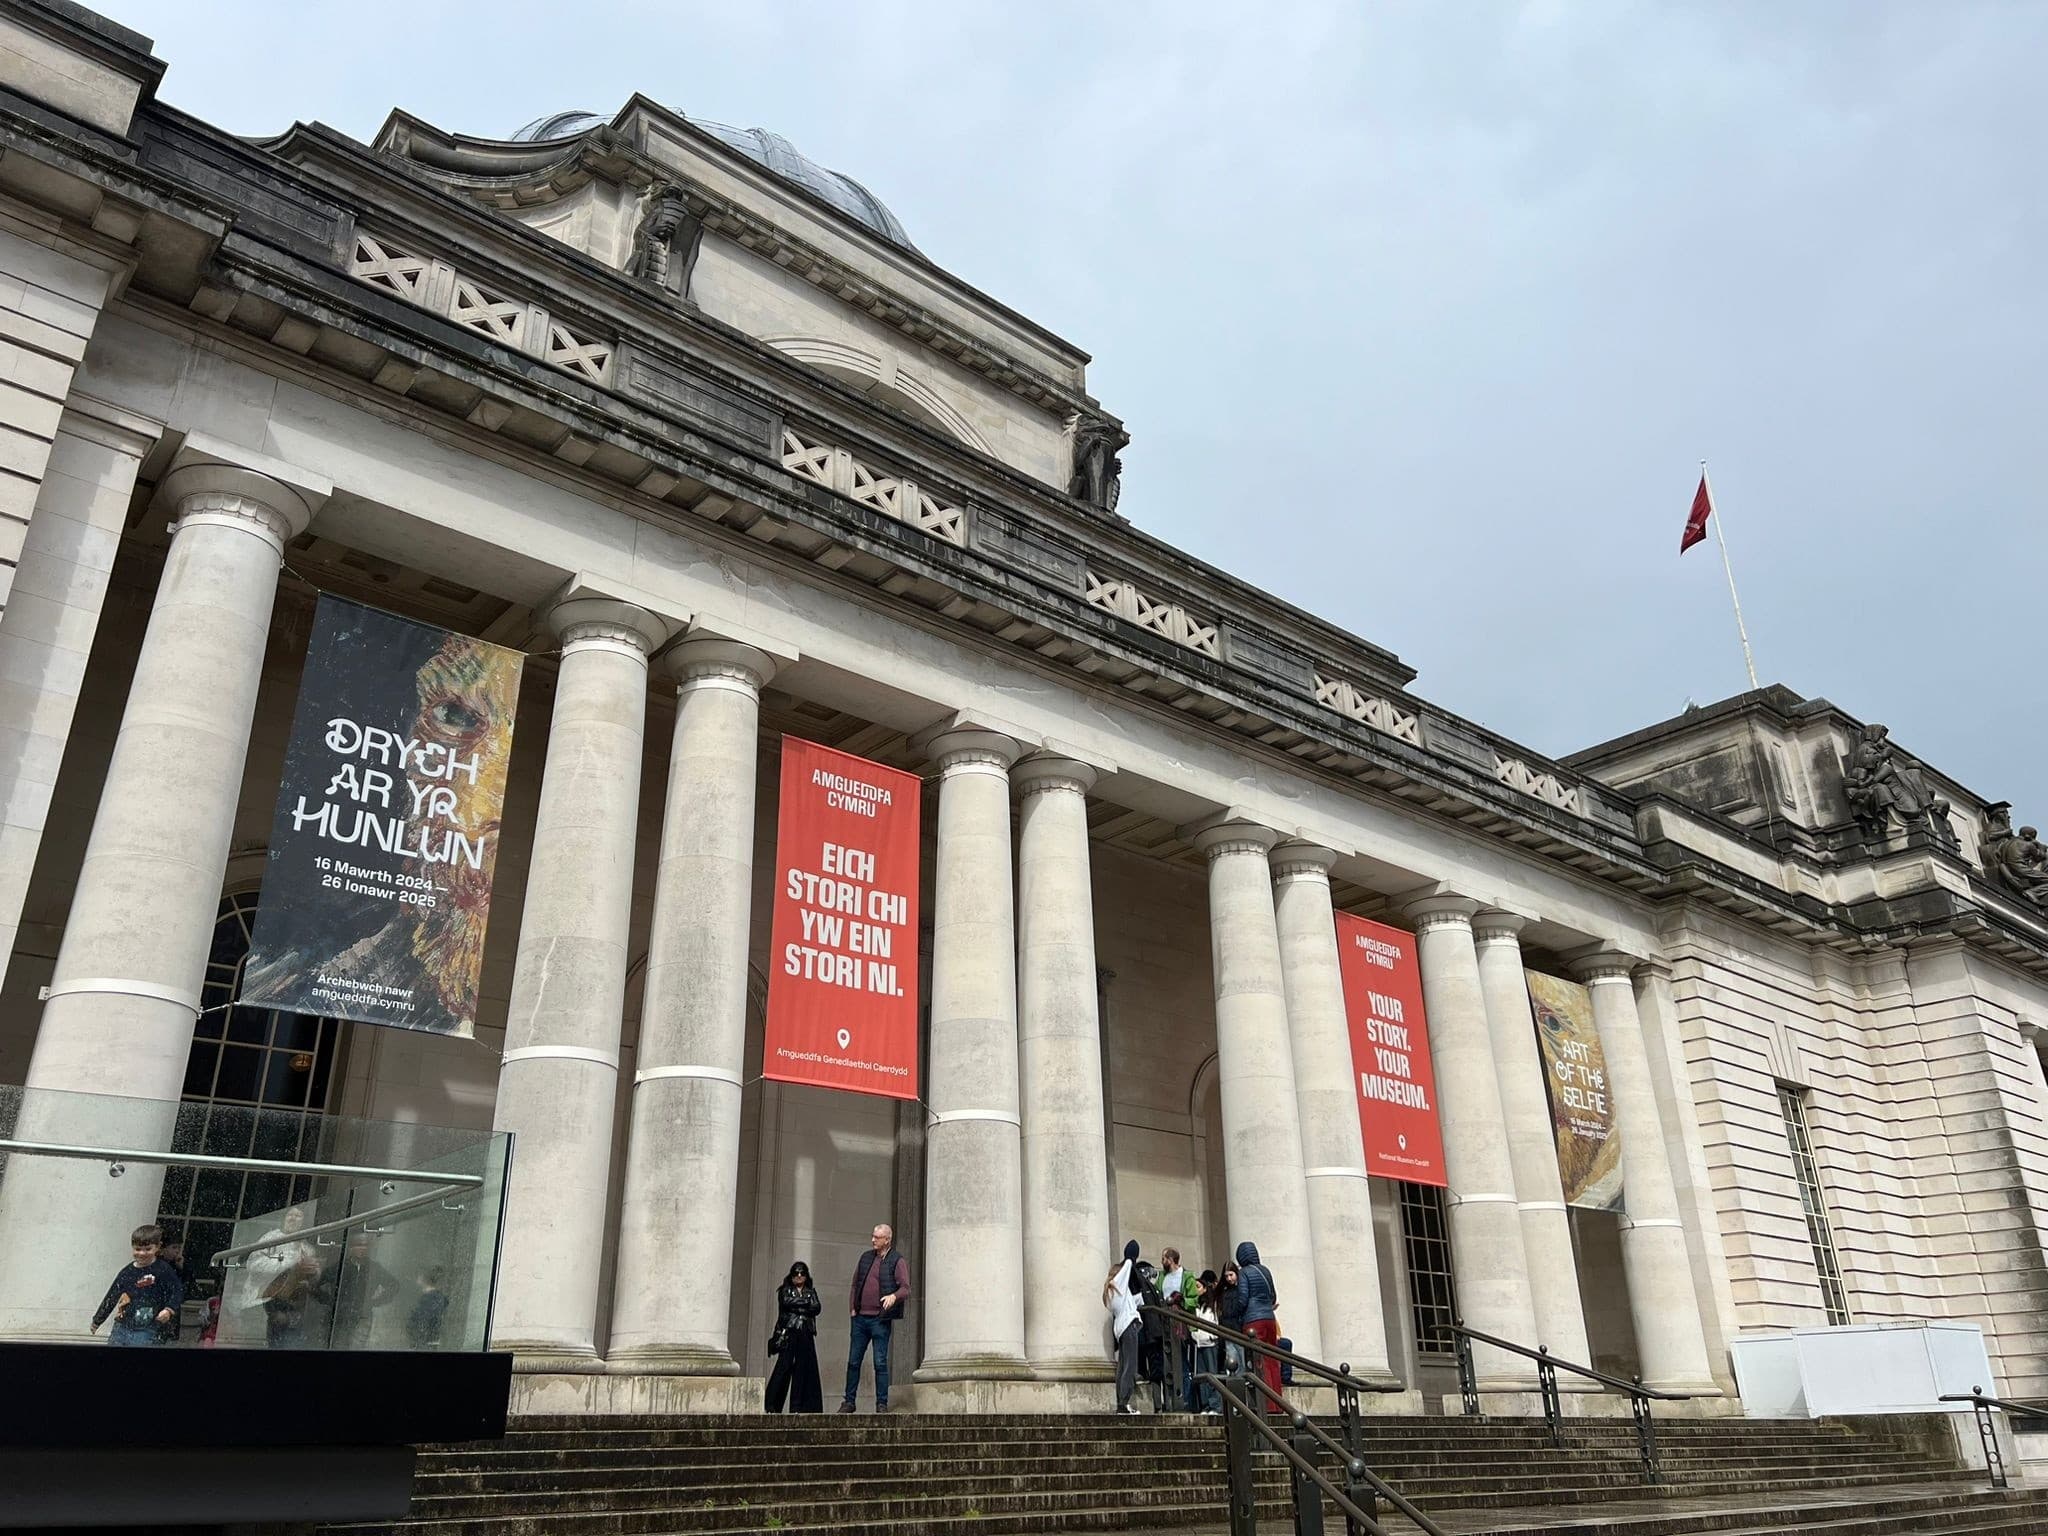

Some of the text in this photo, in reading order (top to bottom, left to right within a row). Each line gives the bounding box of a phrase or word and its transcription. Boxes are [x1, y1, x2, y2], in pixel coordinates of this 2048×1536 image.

[325, 718, 479, 785] DRYCH
[325, 763, 459, 823] AR YR
[812, 769, 891, 806] AMGUEDDFA
[827, 791, 876, 818] CYMRU
[314, 856, 331, 870] 16
[335, 860, 392, 884] Mawrth
[395, 873, 432, 891] 2024
[822, 841, 875, 884] EICH
[322, 874, 436, 908] 26 Ionawr 2025
[787, 868, 907, 926] STORI CHI
[800, 908, 891, 959] YW EIN
[1356, 934, 1401, 959] AMGUEDDFA
[785, 943, 904, 997] STORI NI.
[1366, 951, 1393, 970] CYMRU
[311, 987, 415, 1012] amgueddfa.cymru
[317, 974, 413, 998] Archebwch nawr
[1367, 990, 1404, 1023] YOUR
[1366, 1017, 1412, 1052] STORY.
[776, 1048, 908, 1076] Amgueddfa Genedlaethol Caerdydd
[1374, 1046, 1411, 1079] YOUR
[1563, 1040, 1589, 1063] ART
[1555, 1060, 1575, 1082] OF
[1361, 1072, 1430, 1111] MUSEUM.
[1563, 1085, 1608, 1114] SELFIE
